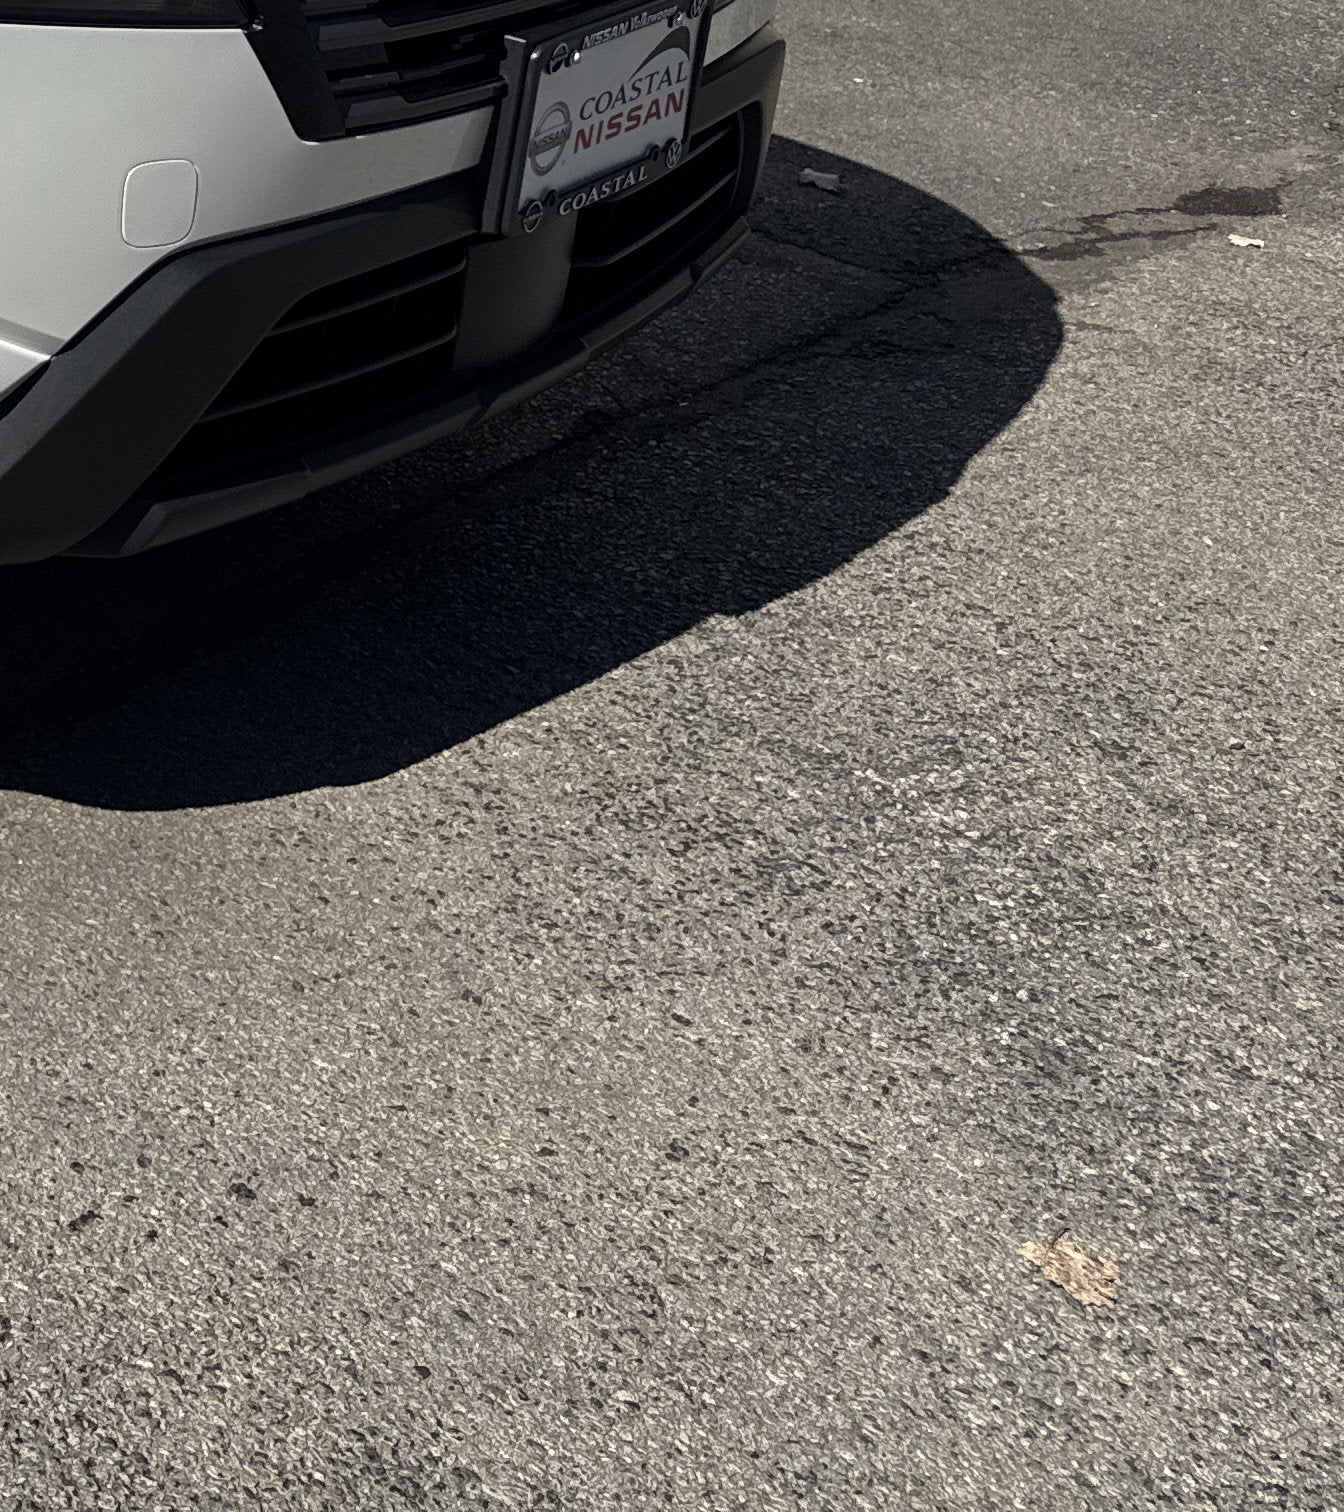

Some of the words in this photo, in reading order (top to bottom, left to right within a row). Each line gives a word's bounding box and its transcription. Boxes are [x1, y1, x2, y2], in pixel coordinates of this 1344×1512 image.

[581, 19, 630, 50] NISSAN
[579, 61, 688, 121] COASTAL
[573, 88, 685, 154] NISSAN
[559, 165, 648, 216] COASTAL
